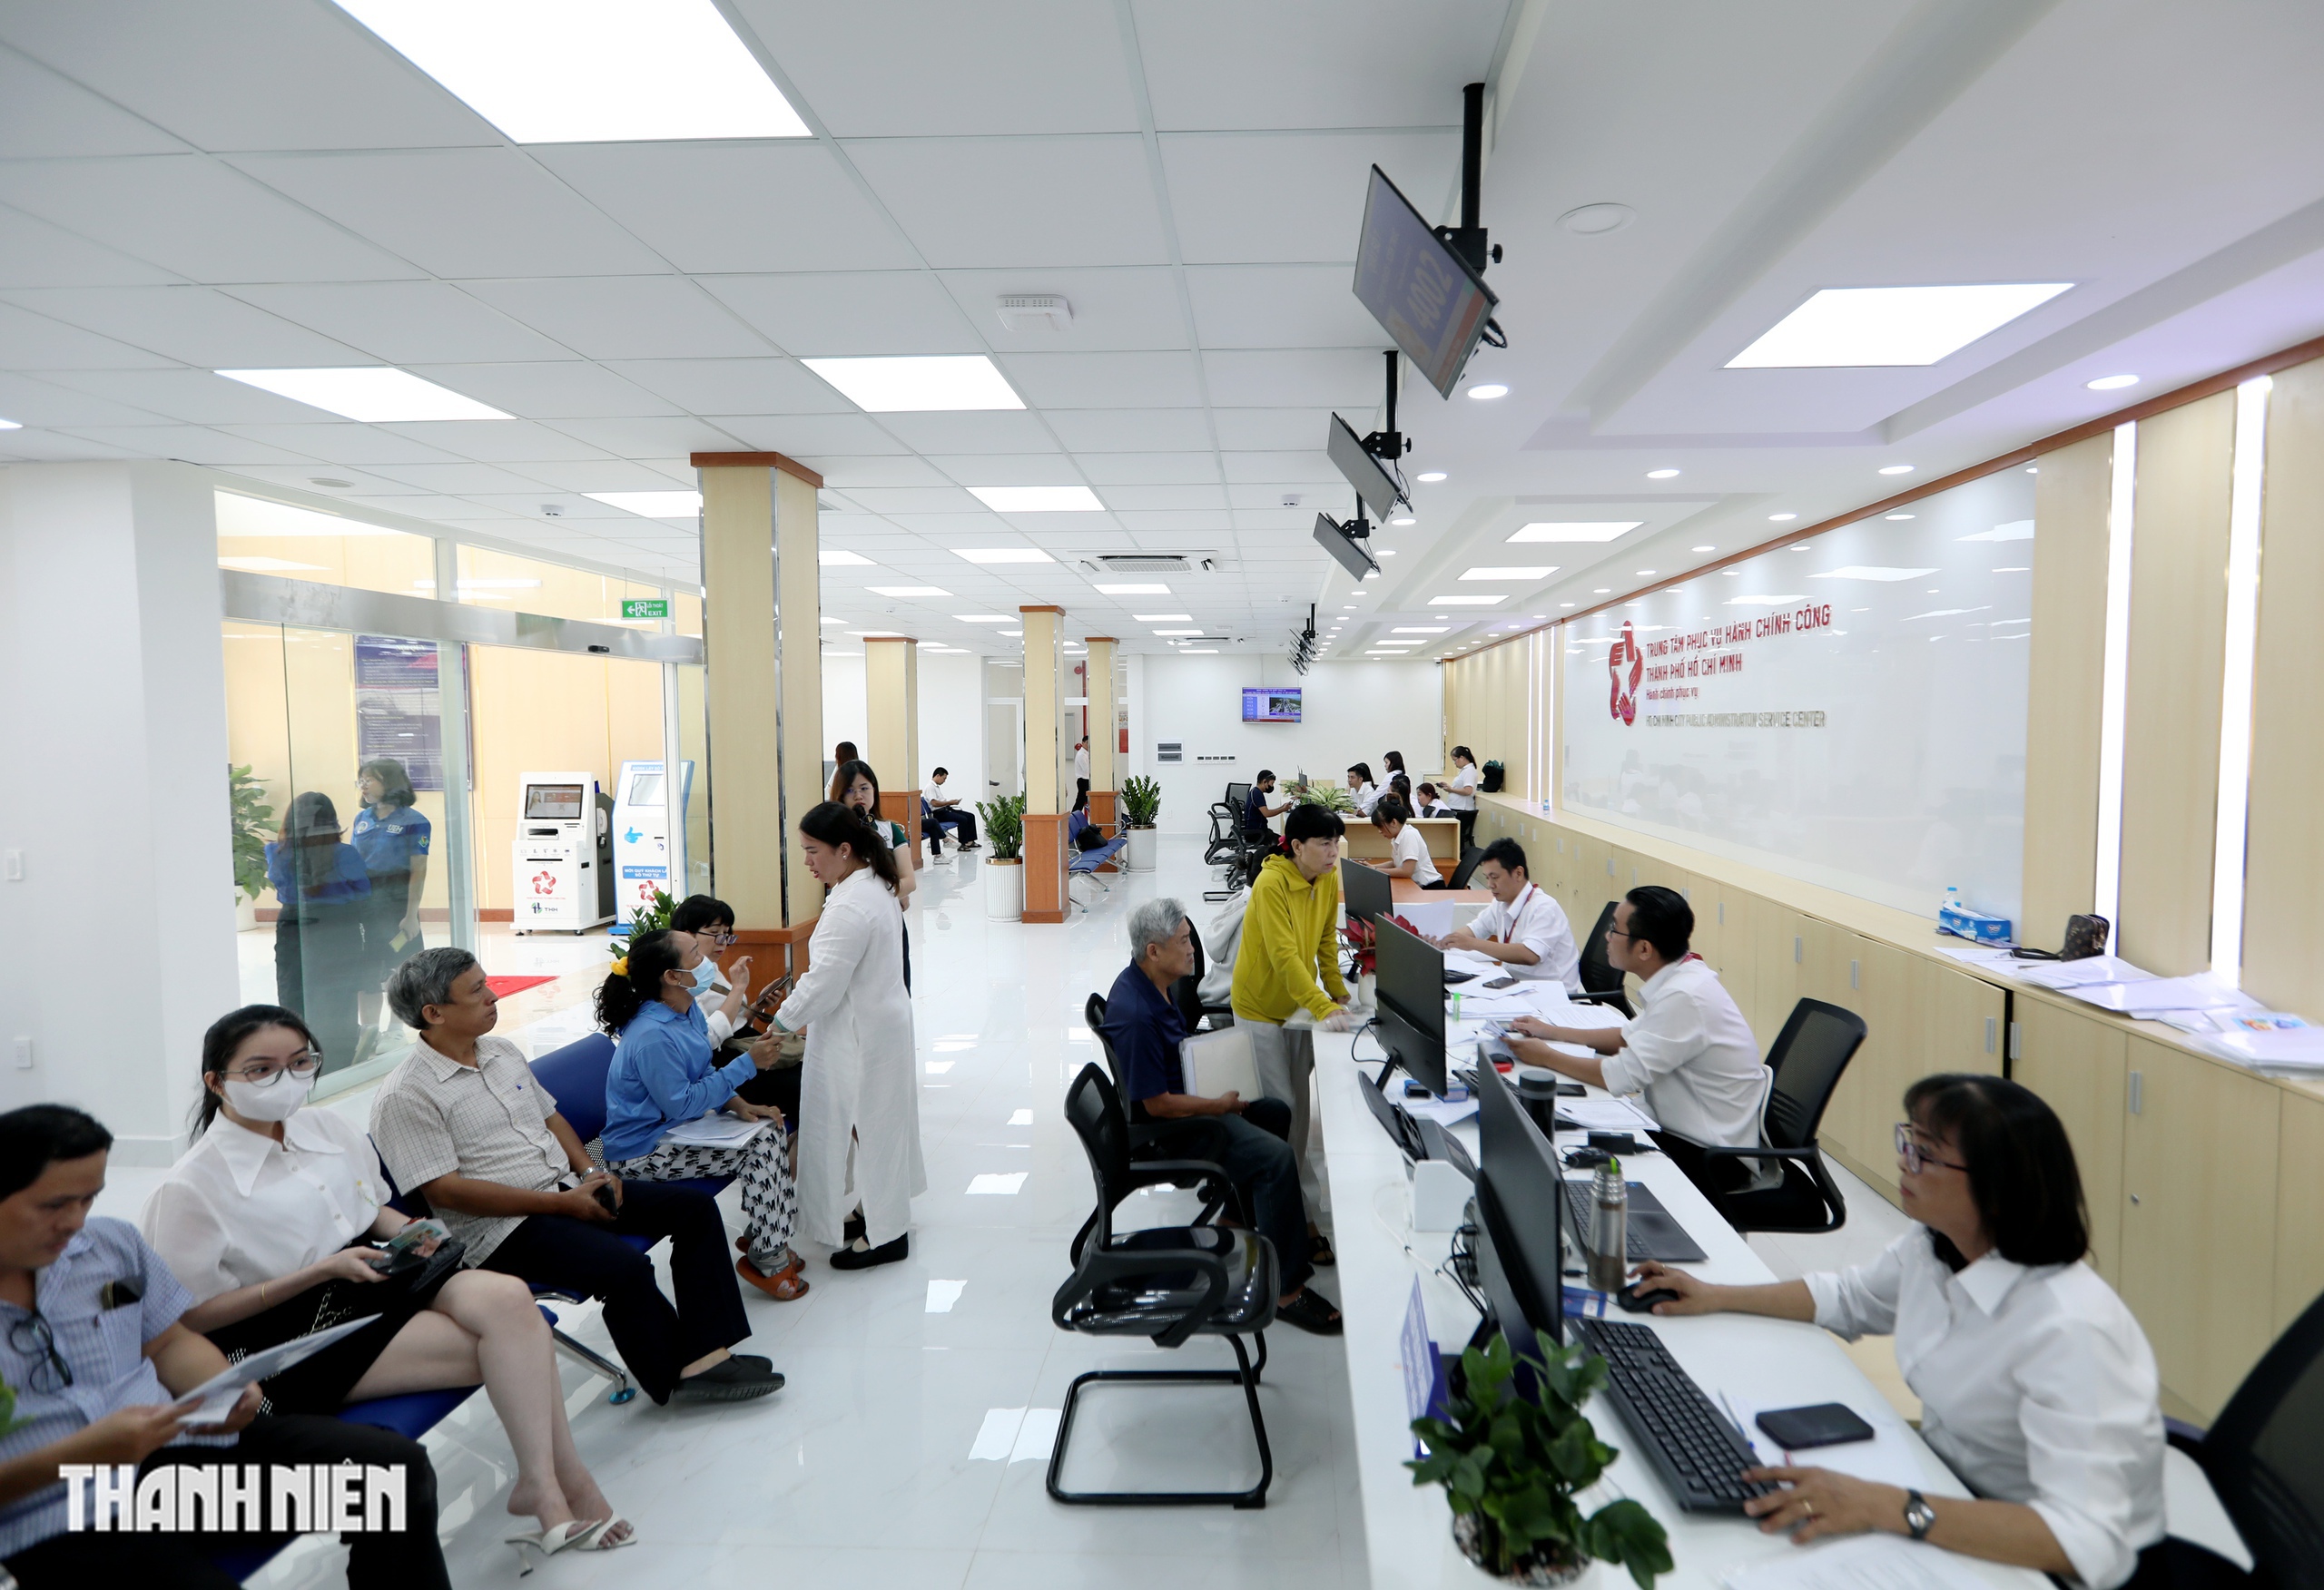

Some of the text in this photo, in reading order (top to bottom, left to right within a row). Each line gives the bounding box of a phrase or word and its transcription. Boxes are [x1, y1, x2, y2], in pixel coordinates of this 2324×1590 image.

[1408, 249, 1452, 330] 4002
[1647, 604, 1832, 658] TRUNG TÂM PHỤC VỤ HÀNH CHÍNH CÔNG
[1647, 663, 1669, 682] THÀNH
[1670, 657, 1685, 679] PHỐ
[1702, 653, 1717, 676] CHÍ
[1718, 653, 1743, 674] MINH
[1758, 712, 1791, 727] SERVICE
[1792, 711, 1827, 727] CENTER
[387, 823, 404, 833] UEH
